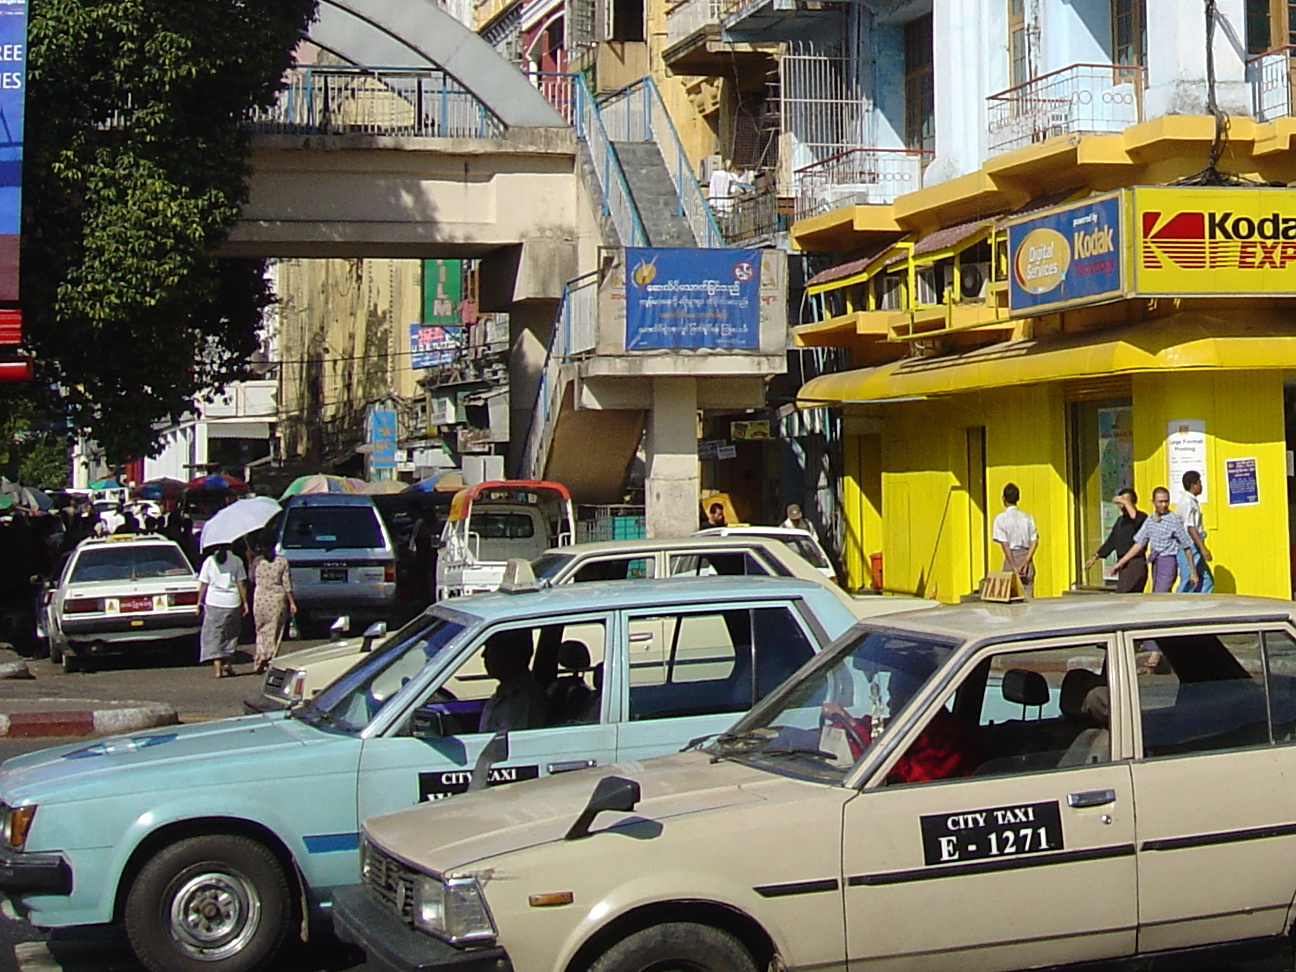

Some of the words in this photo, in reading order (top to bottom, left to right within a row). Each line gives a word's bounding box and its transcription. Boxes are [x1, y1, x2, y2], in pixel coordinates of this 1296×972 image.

[0, 44, 23, 61] EE
[0, 72, 21, 89] ES
[1073, 224, 1114, 260] Kodak
[1028, 241, 1054, 265] Digital
[1026, 262, 1058, 280] Services
[984, 577, 1011, 598] TAXI
[487, 768, 517, 782] AXI
[946, 812, 987, 831] CITY
[993, 807, 1036, 825] TAXI
[937, 835, 960, 862] E
[987, 826, 1050, 856] 1271
